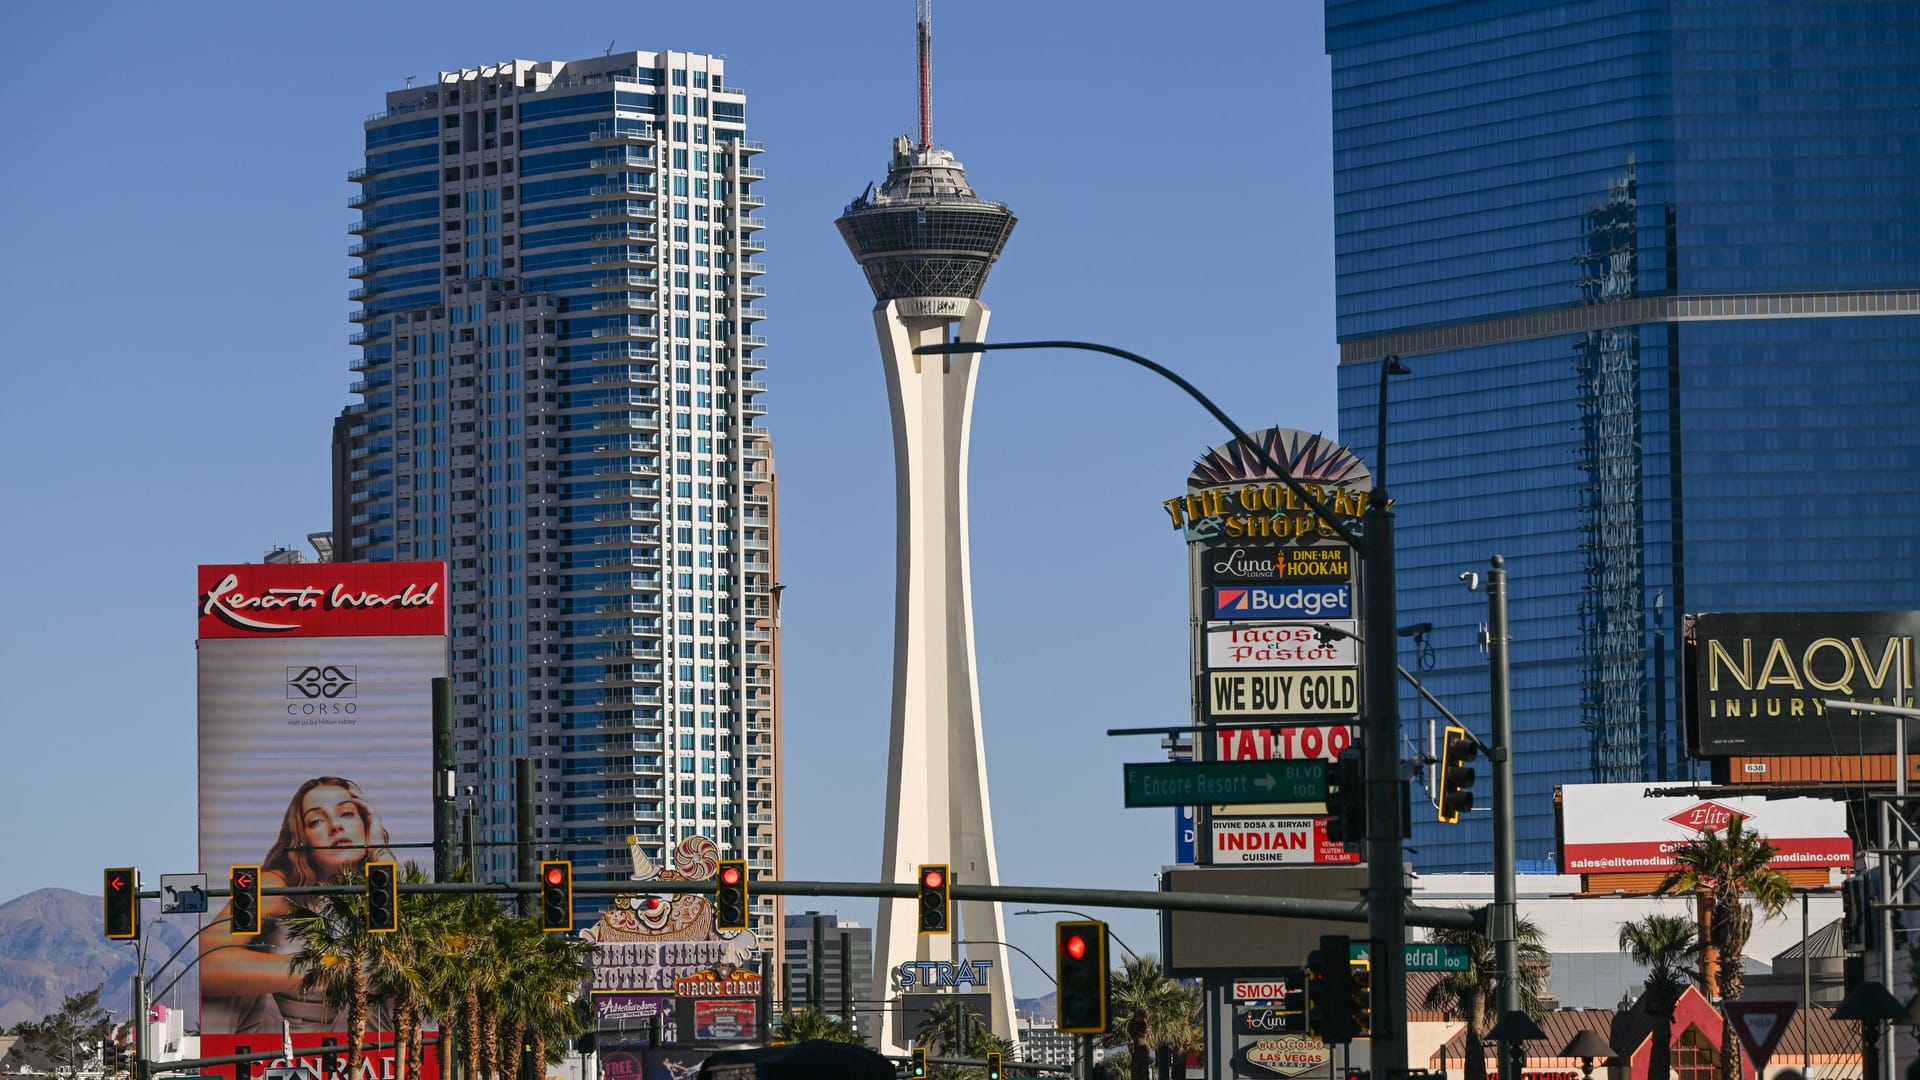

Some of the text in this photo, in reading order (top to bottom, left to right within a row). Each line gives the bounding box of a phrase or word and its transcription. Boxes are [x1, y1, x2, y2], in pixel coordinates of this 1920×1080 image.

[1163, 486, 1231, 529] THE
[1240, 483, 1327, 511] GOLD
[1226, 515, 1337, 537] SHOPS
[1214, 549, 1276, 577] Luna
[1287, 562, 1348, 576] HOOKAH
[204, 573, 439, 630] Resorts World
[1252, 589, 1347, 615] Budget
[1227, 646, 1340, 663] Pastor
[1708, 637, 1913, 695] NAQVI
[1215, 675, 1355, 710] WE BUY GOLD
[287, 702, 357, 715] CORSO
[1710, 698, 1824, 718] INJURY
[1218, 725, 1351, 762] TATTOO
[1128, 767, 1322, 796] E Encore Resort BLVD
[1293, 784, 1316, 797] 100
[1690, 804, 1730, 824] Elite
[1278, 821, 1312, 829] BIRYANI
[1219, 832, 1307, 850] INDIAN
[1242, 853, 1283, 861] CUISINE
[592, 943, 657, 966] CIRCUS
[1444, 958, 1460, 967] 100
[592, 967, 656, 990] HOTEL
[900, 958, 993, 987] STRAT
[678, 981, 762, 996] CIRCUS CIRCU
[1236, 984, 1286, 998] SMOK
[1259, 1041, 1322, 1050] WELCOME
[605, 1062, 632, 1074] FREE
[1260, 1053, 1322, 1063] LAS VEGAS
